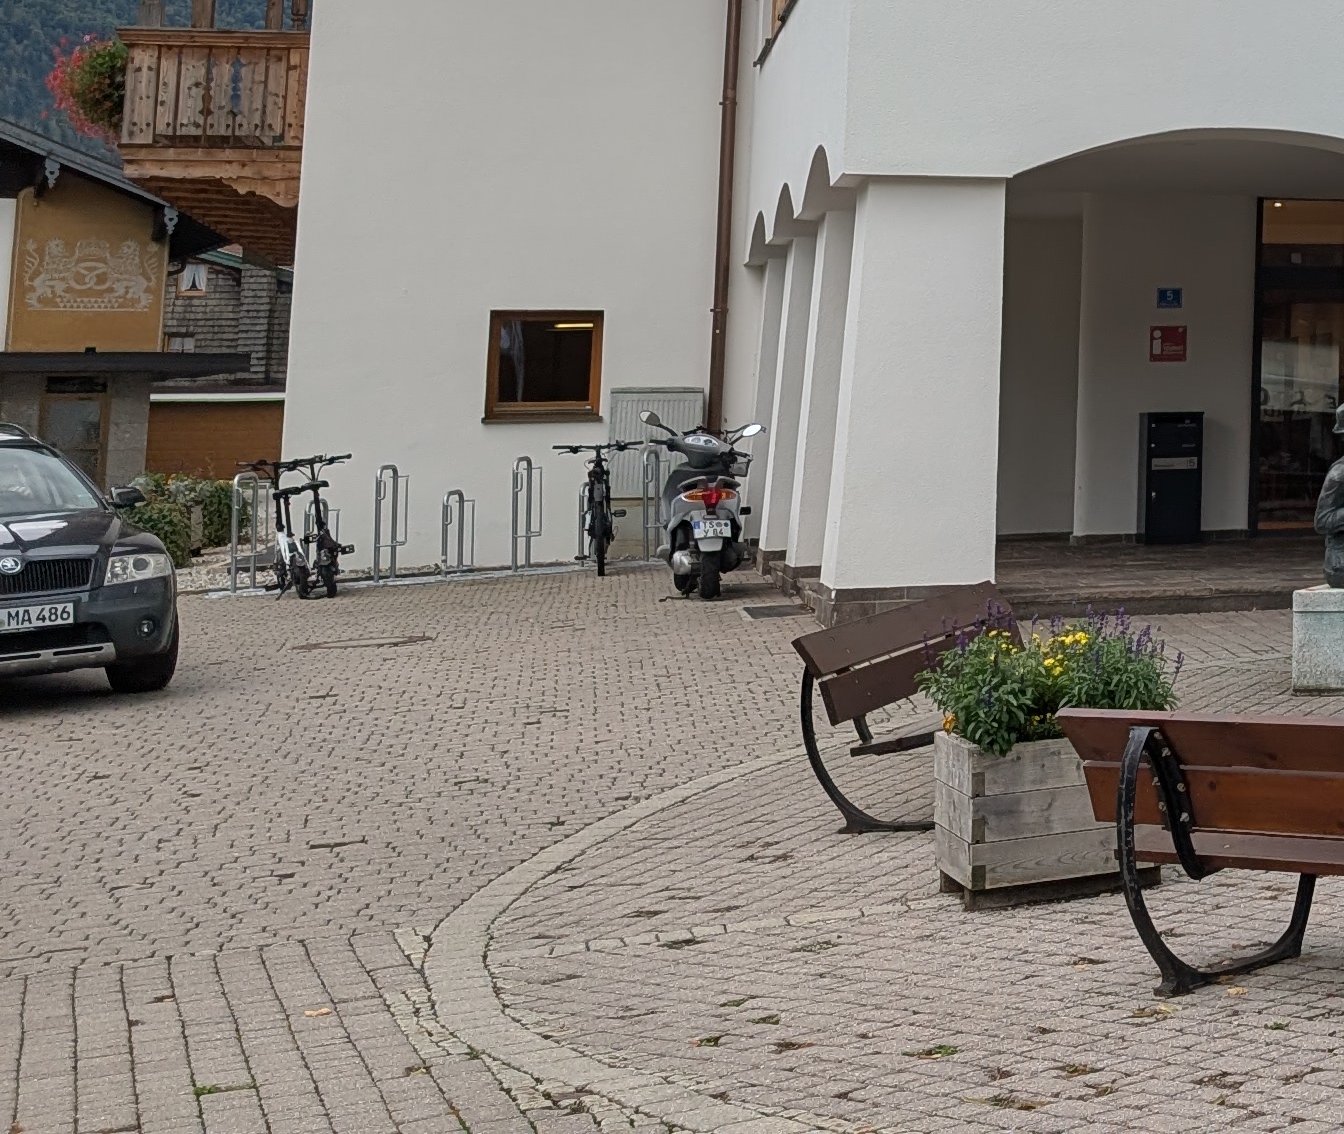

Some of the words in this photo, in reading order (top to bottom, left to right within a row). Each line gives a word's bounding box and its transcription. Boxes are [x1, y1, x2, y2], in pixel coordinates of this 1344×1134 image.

[1166, 290, 1174, 301] 5
[7, 609, 32, 627] MA
[36, 606, 71, 624] 486
